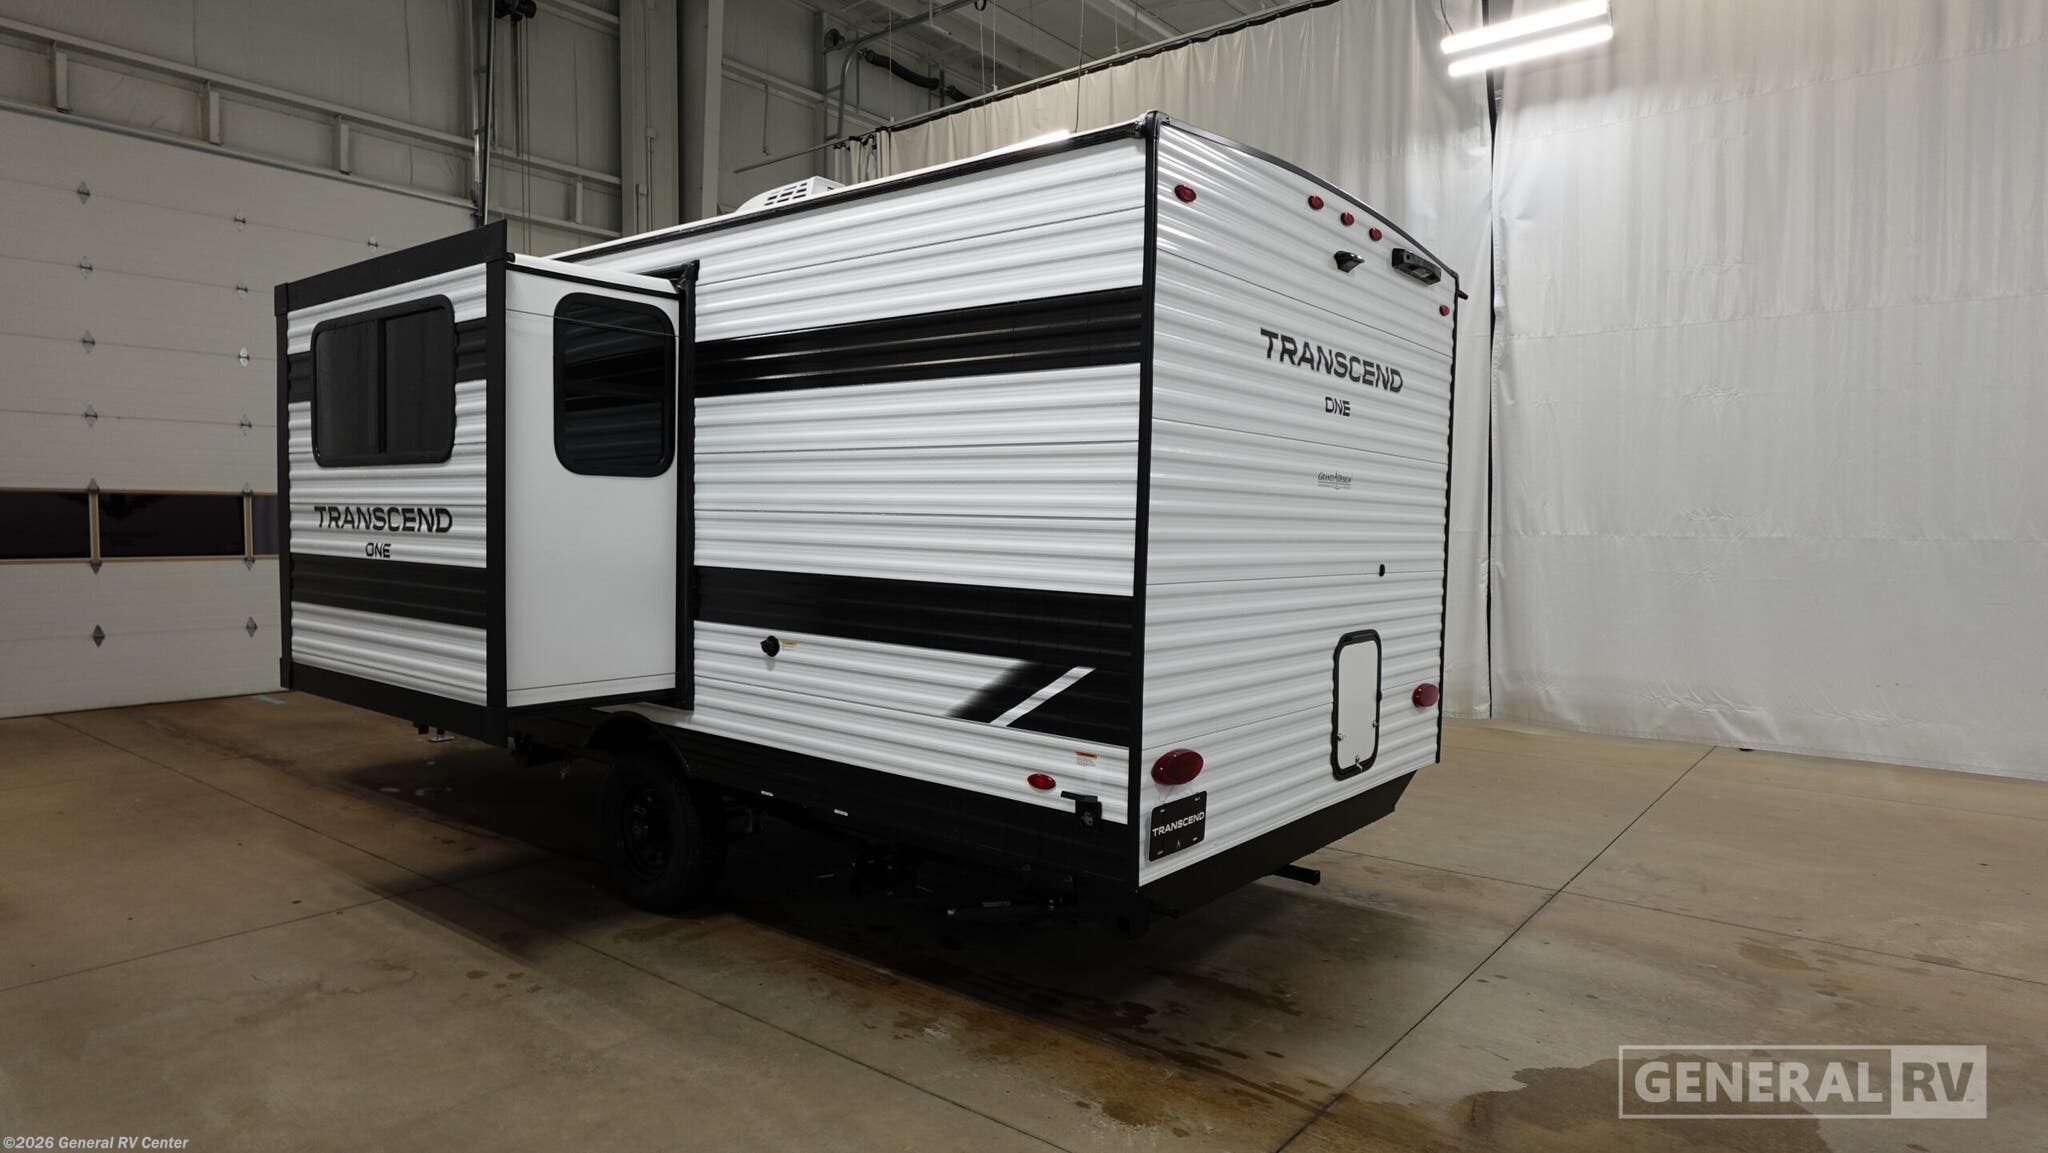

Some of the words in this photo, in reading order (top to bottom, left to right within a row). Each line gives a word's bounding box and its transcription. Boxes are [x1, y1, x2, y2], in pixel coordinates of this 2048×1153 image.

[1260, 328, 1404, 393] TRANSCEND
[314, 505, 453, 533] TRANSCEND
[365, 542, 391, 558] ONE
[1152, 811, 1205, 837] TRANSCEND
